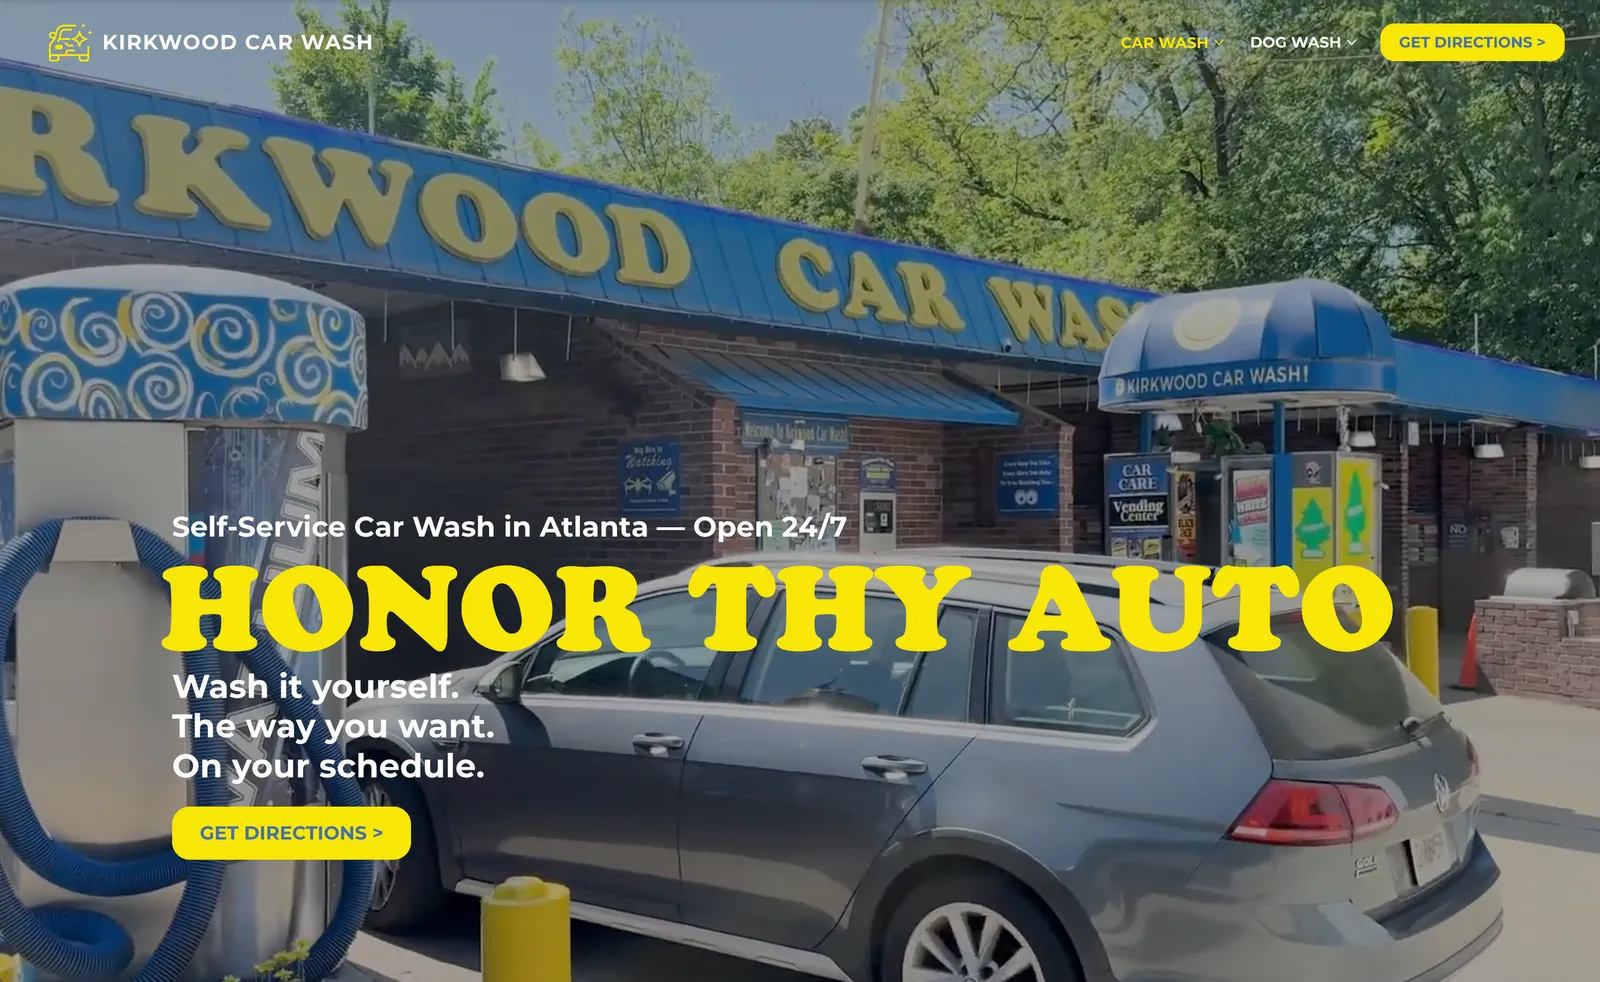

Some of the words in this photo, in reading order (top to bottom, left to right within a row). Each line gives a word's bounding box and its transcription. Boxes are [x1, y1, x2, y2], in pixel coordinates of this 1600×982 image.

[777, 237, 966, 333] CAR
[986, 275, 1143, 352] WAS
[1127, 373, 1208, 394] KIRKWOOD
[1212, 370, 1245, 388] CAR
[625, 453, 672, 471] Watching
[1122, 463, 1153, 478] CAR
[1118, 477, 1158, 491] CARE
[1112, 499, 1165, 516] Vending
[1120, 511, 1158, 523] Center
[1449, 523, 1468, 536] NO
